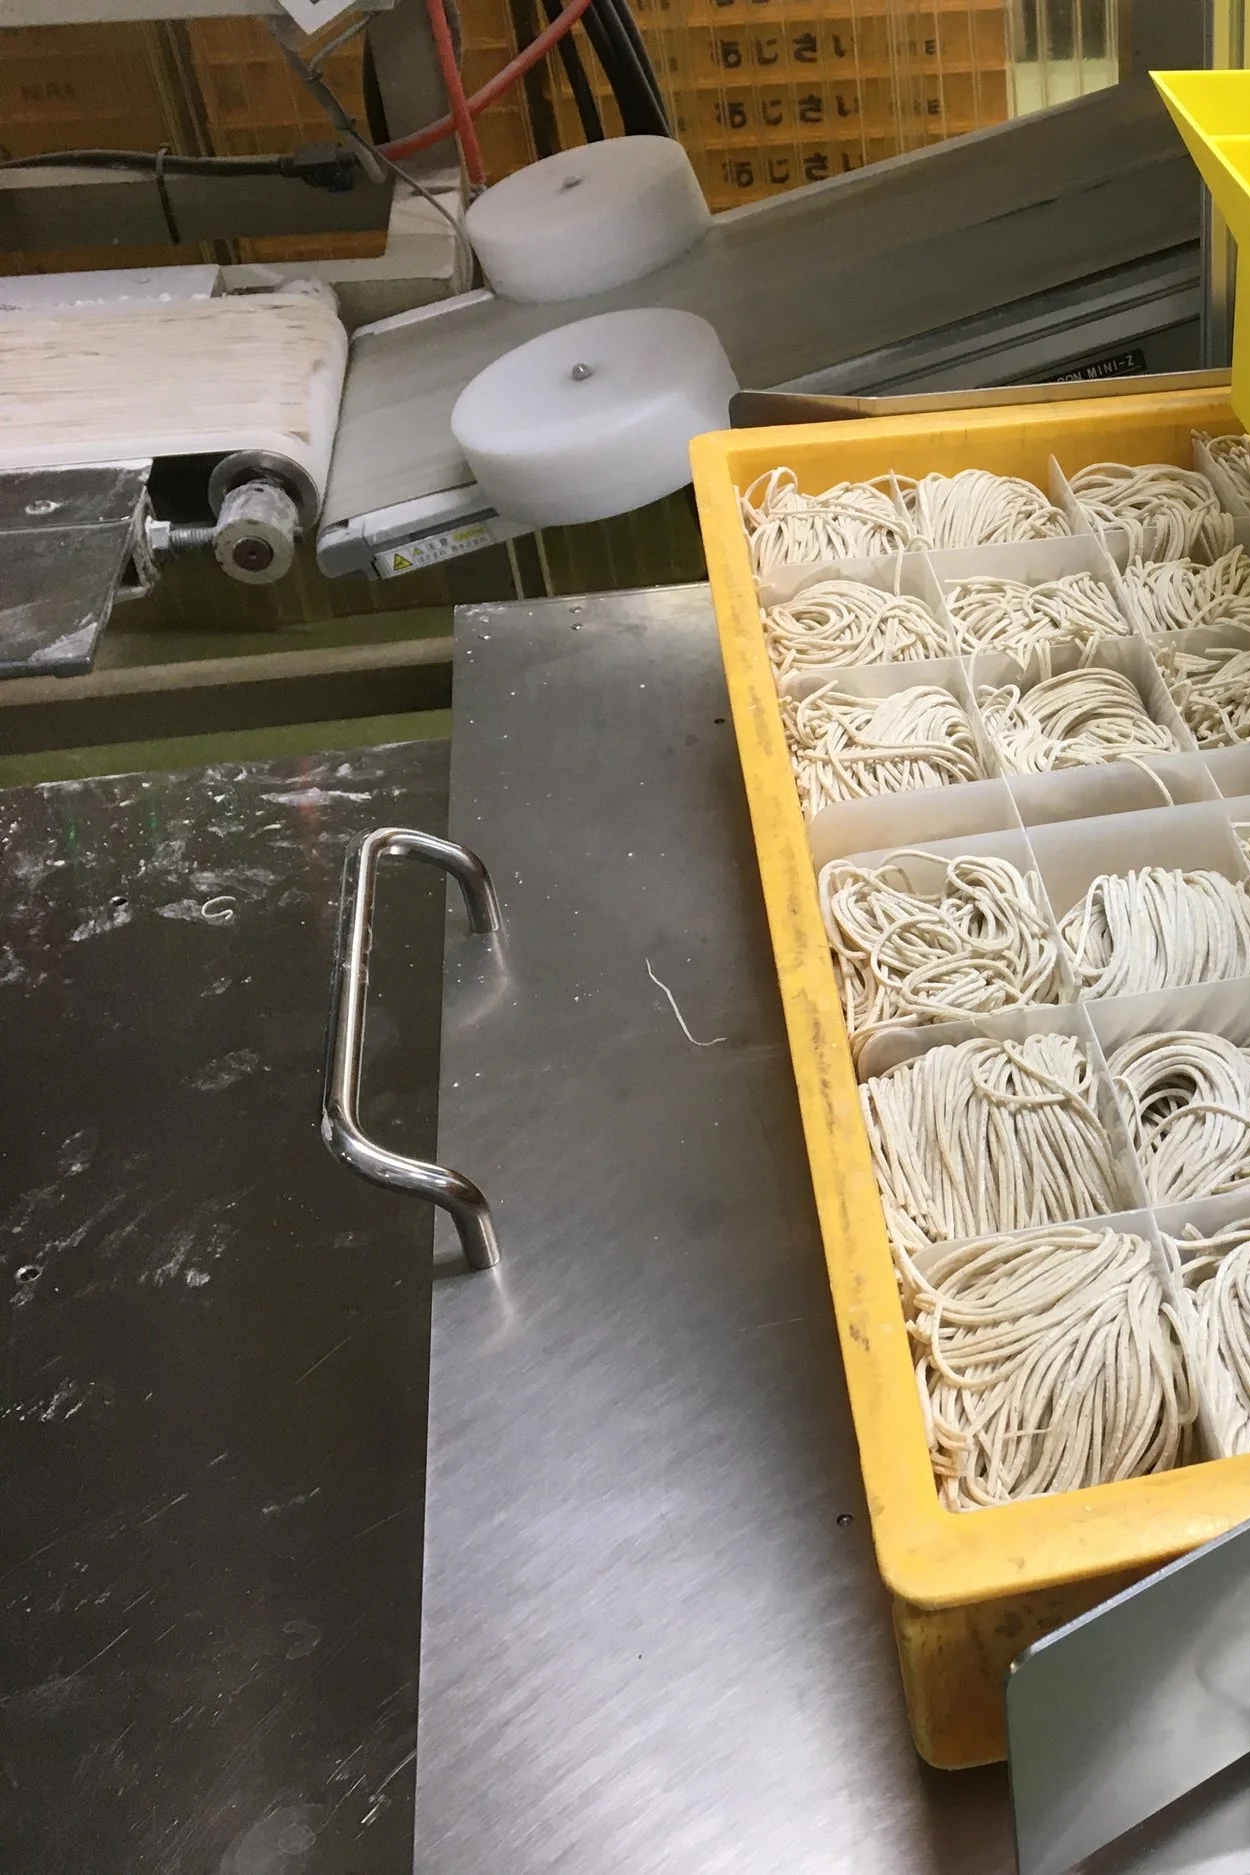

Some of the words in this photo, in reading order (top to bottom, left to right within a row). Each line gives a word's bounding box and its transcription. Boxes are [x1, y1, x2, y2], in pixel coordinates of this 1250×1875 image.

[711, 32, 858, 69] あじさい
[714, 94, 859, 130] あじさい
[721, 152, 866, 188] あじさい
[1086, 354, 1135, 380] MINI-Z
